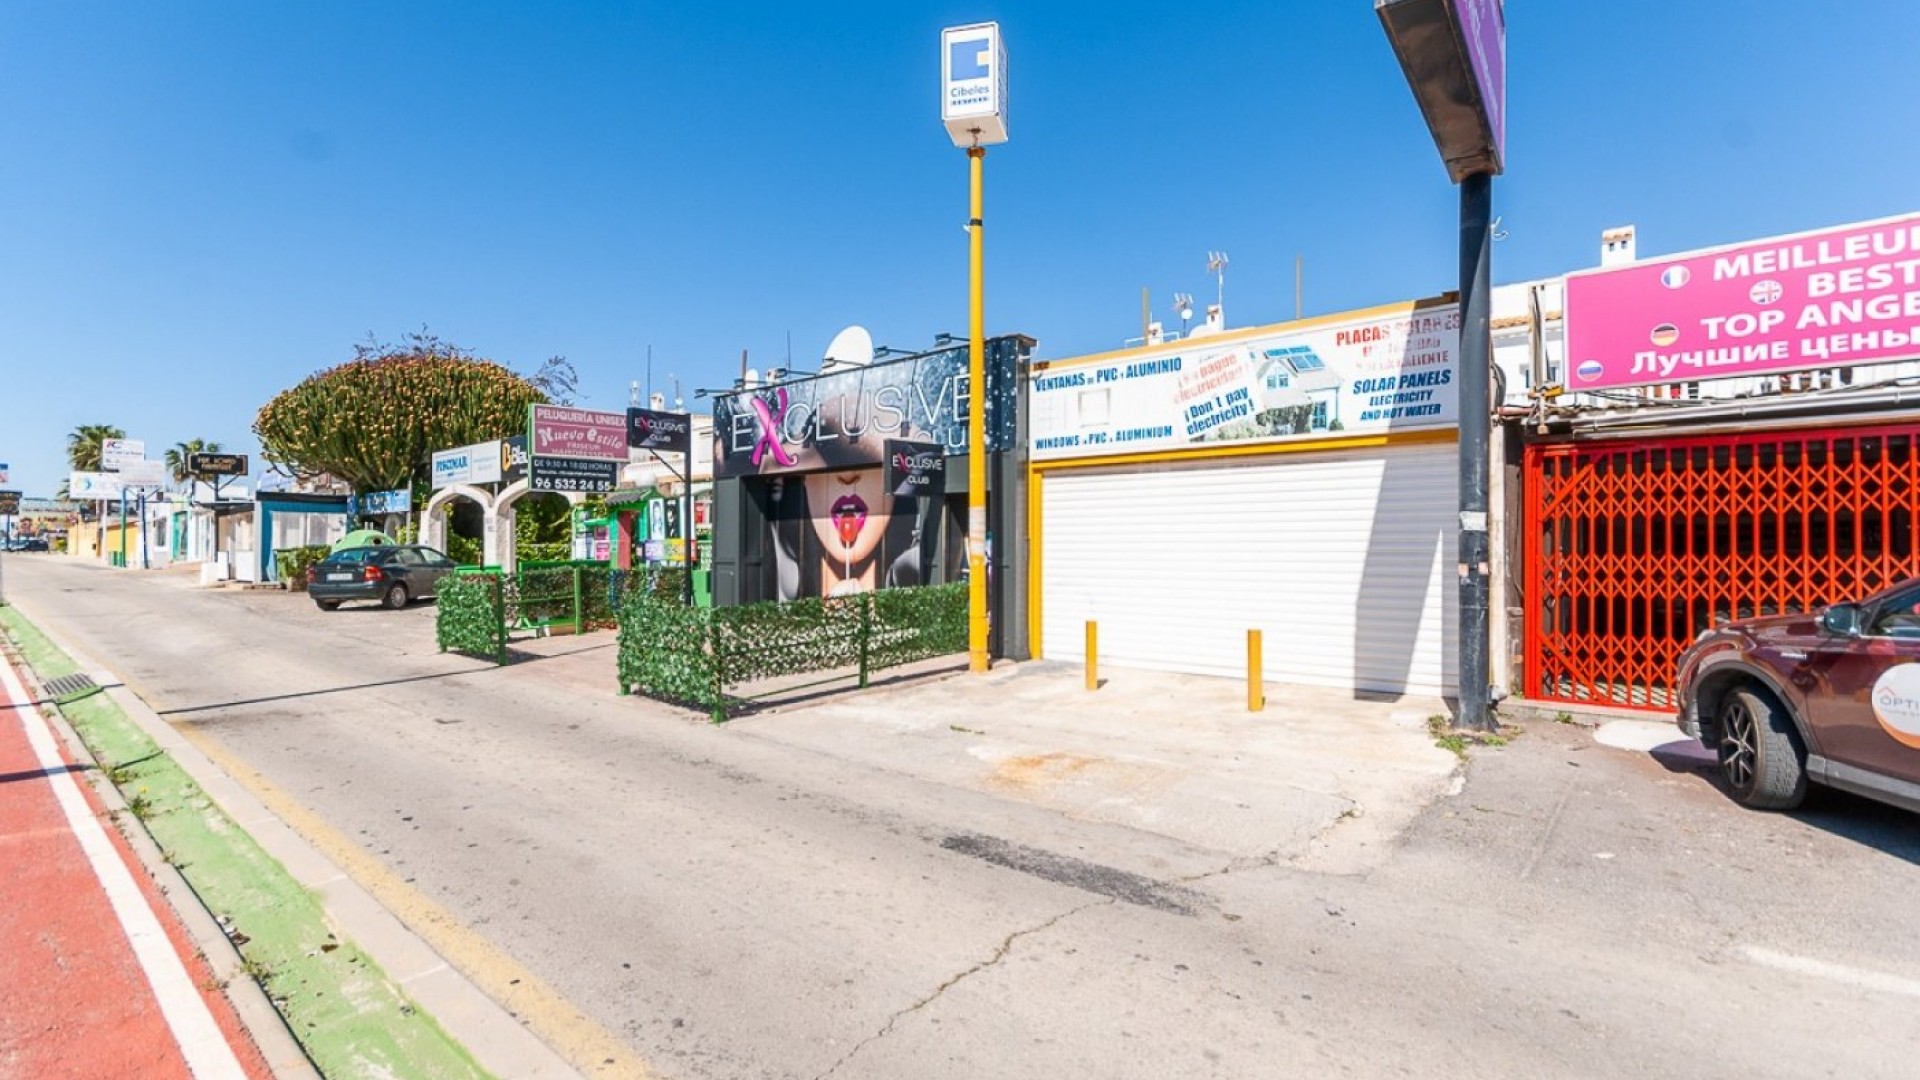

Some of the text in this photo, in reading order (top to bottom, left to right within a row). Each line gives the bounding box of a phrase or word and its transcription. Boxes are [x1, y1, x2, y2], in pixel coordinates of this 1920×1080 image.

[951, 86, 989, 97] Cibeles
[1808, 258, 1920, 298] BEST
[1700, 290, 1920, 340] TOP ANGE
[1336, 325, 1390, 348] PLACAS
[1035, 372, 1085, 392] VENTANAS
[1097, 367, 1118, 383] PVC
[1126, 356, 1181, 378] ALUMINIO
[1353, 369, 1451, 395] SOLAR PANELS
[1226, 387, 1248, 405] pay
[1369, 389, 1433, 406] ELECTRICITY
[597, 414, 626, 427] UNISEX
[731, 374, 970, 467] EXCLUSIVE
[1360, 403, 1442, 421] AND HOT WATER
[635, 413, 686, 434] EXCLUSIVE
[538, 427, 585, 447] Nuevo
[1035, 435, 1080, 450] WINDOWS
[1089, 432, 1107, 445] PVC
[1115, 426, 1172, 442] ALUMINIUM
[892, 451, 943, 473] EXCLUSIVE
[535, 477, 551, 490] 96
[554, 478, 577, 491] 532
[579, 480, 595, 491] 24
[908, 475, 930, 485] CLUB
